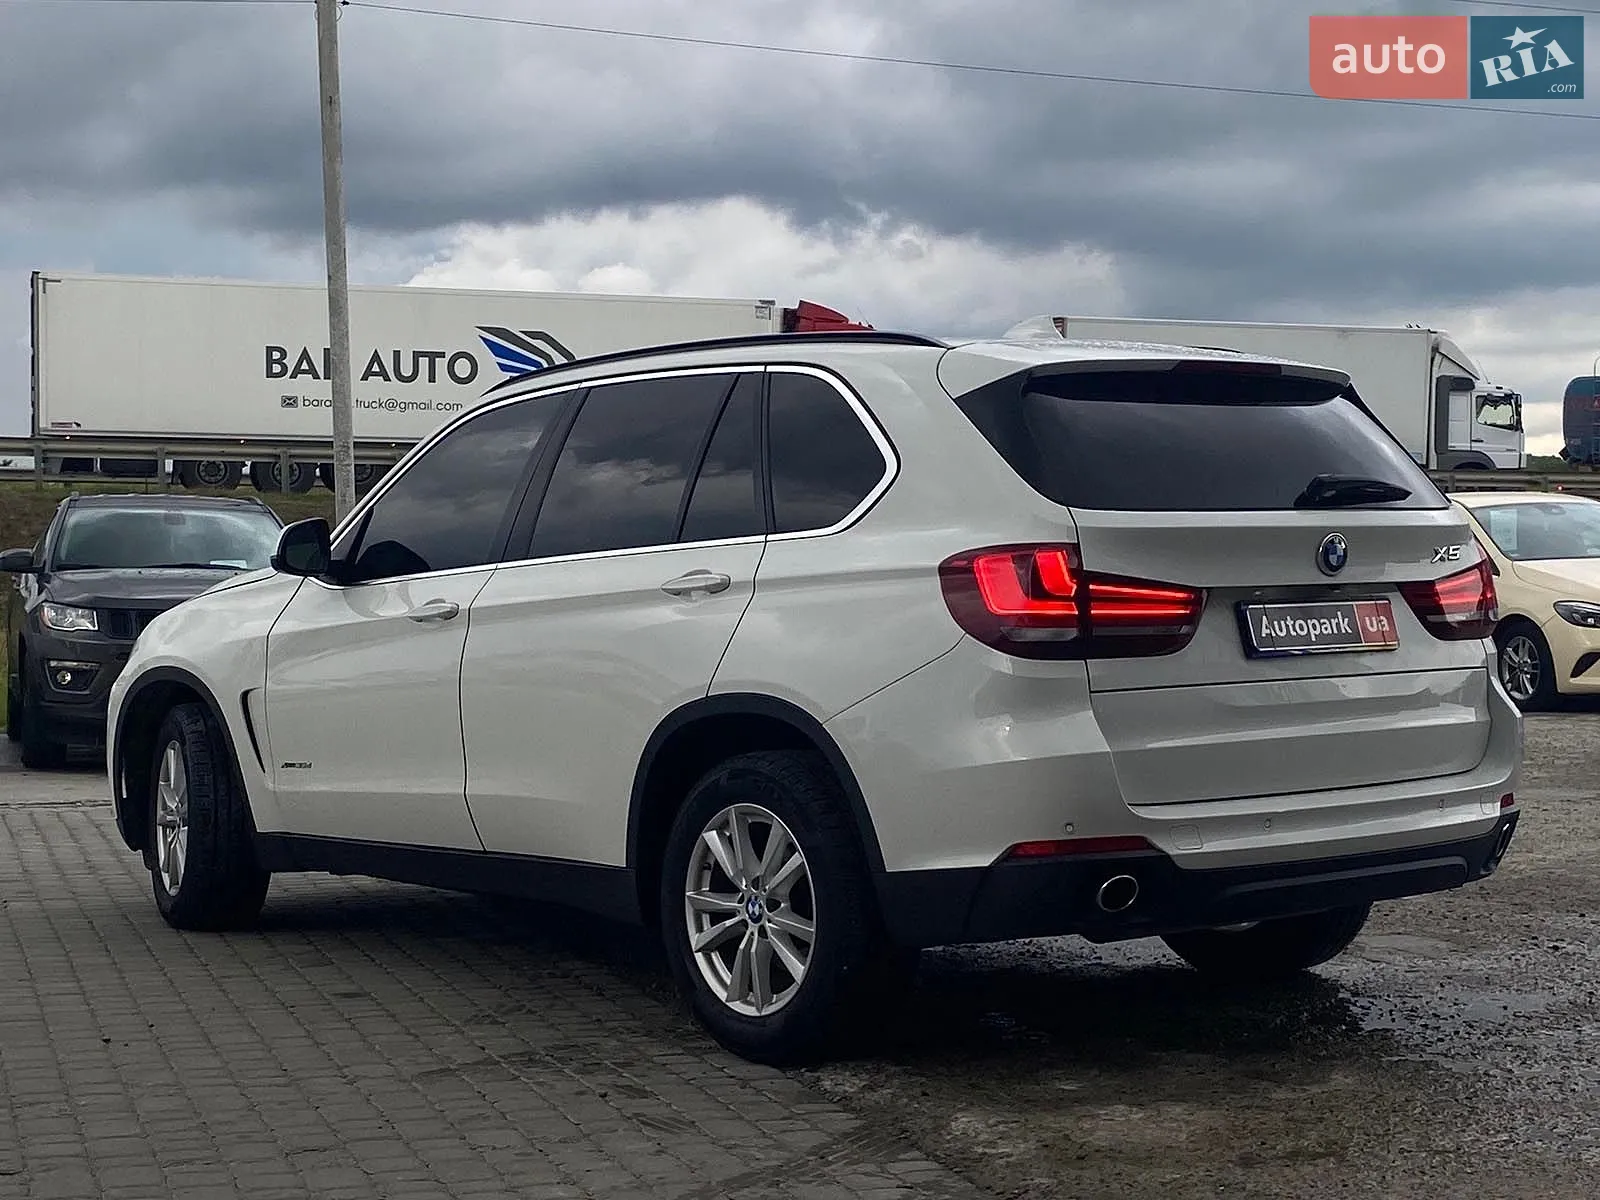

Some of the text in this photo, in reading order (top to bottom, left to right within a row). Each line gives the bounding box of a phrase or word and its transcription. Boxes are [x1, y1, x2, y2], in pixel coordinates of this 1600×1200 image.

[360, 348, 479, 385] AUTO
[302, 396, 464, 413] bara.truck@gmail.com
[1431, 545, 1461, 563] X5
[1261, 611, 1390, 641] Autopark ua
